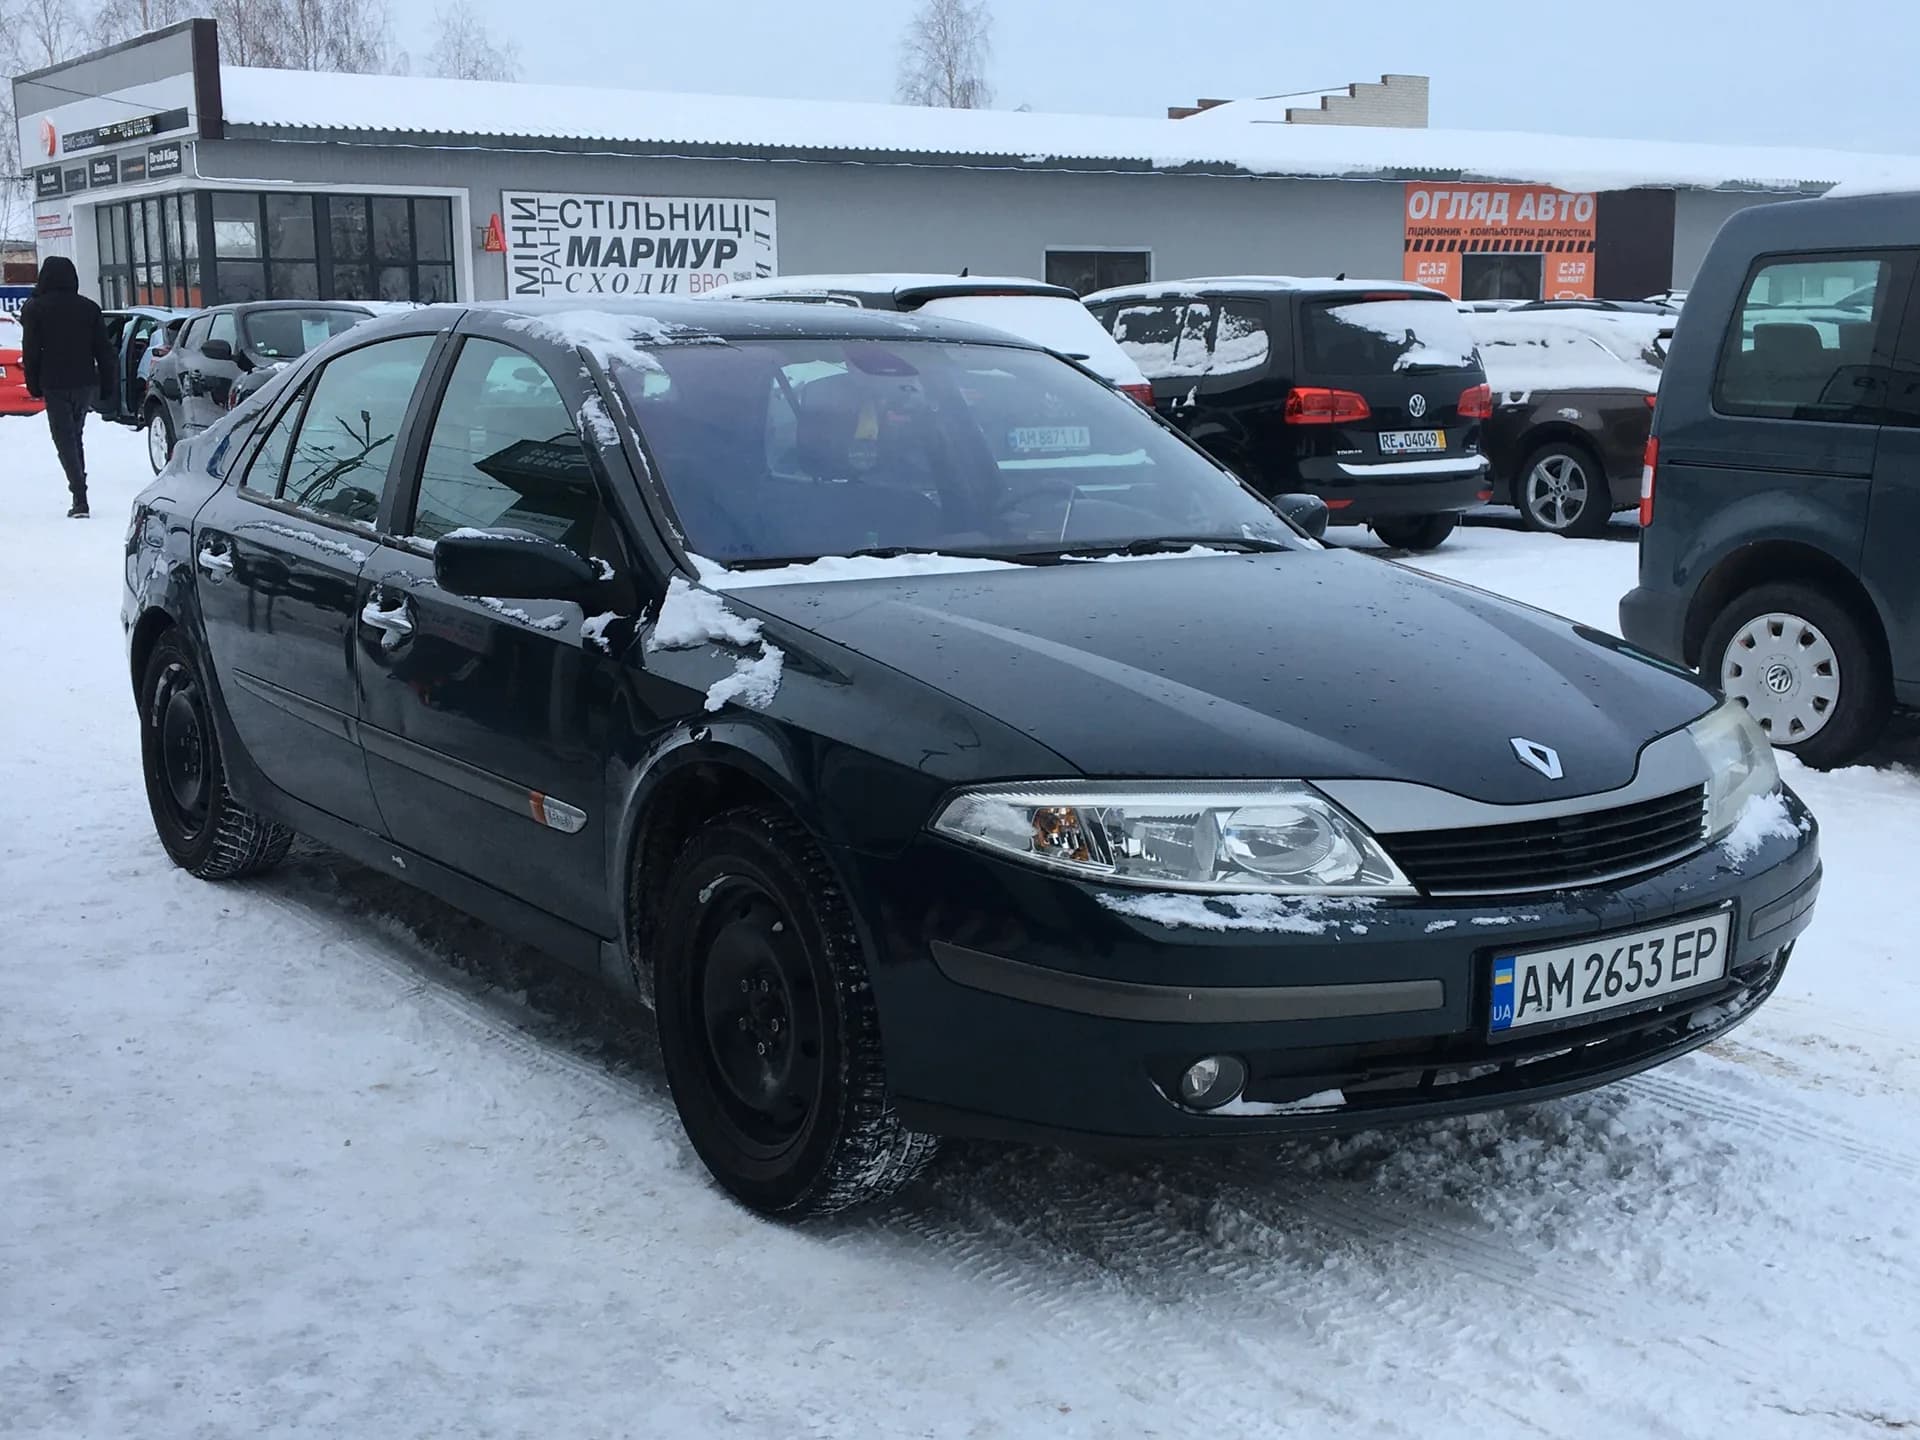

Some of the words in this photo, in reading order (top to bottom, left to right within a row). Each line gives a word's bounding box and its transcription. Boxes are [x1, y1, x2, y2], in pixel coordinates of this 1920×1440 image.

[559, 199, 750, 238] СТІЛЬНИЦІ
[1408, 191, 1510, 225] ОГЛЯД
[1516, 193, 1594, 222] АВТО
[1408, 227, 1462, 237] ПІДЙОМНИК
[566, 236, 738, 269] МАРМУР
[565, 272, 678, 294] СХОДИ
[1404, 432, 1438, 447] 04049
[1517, 957, 1575, 1018] AM
[1582, 938, 1665, 1004] 2653
[1671, 926, 1718, 983] EP
[1493, 1005, 1512, 1022] UA
